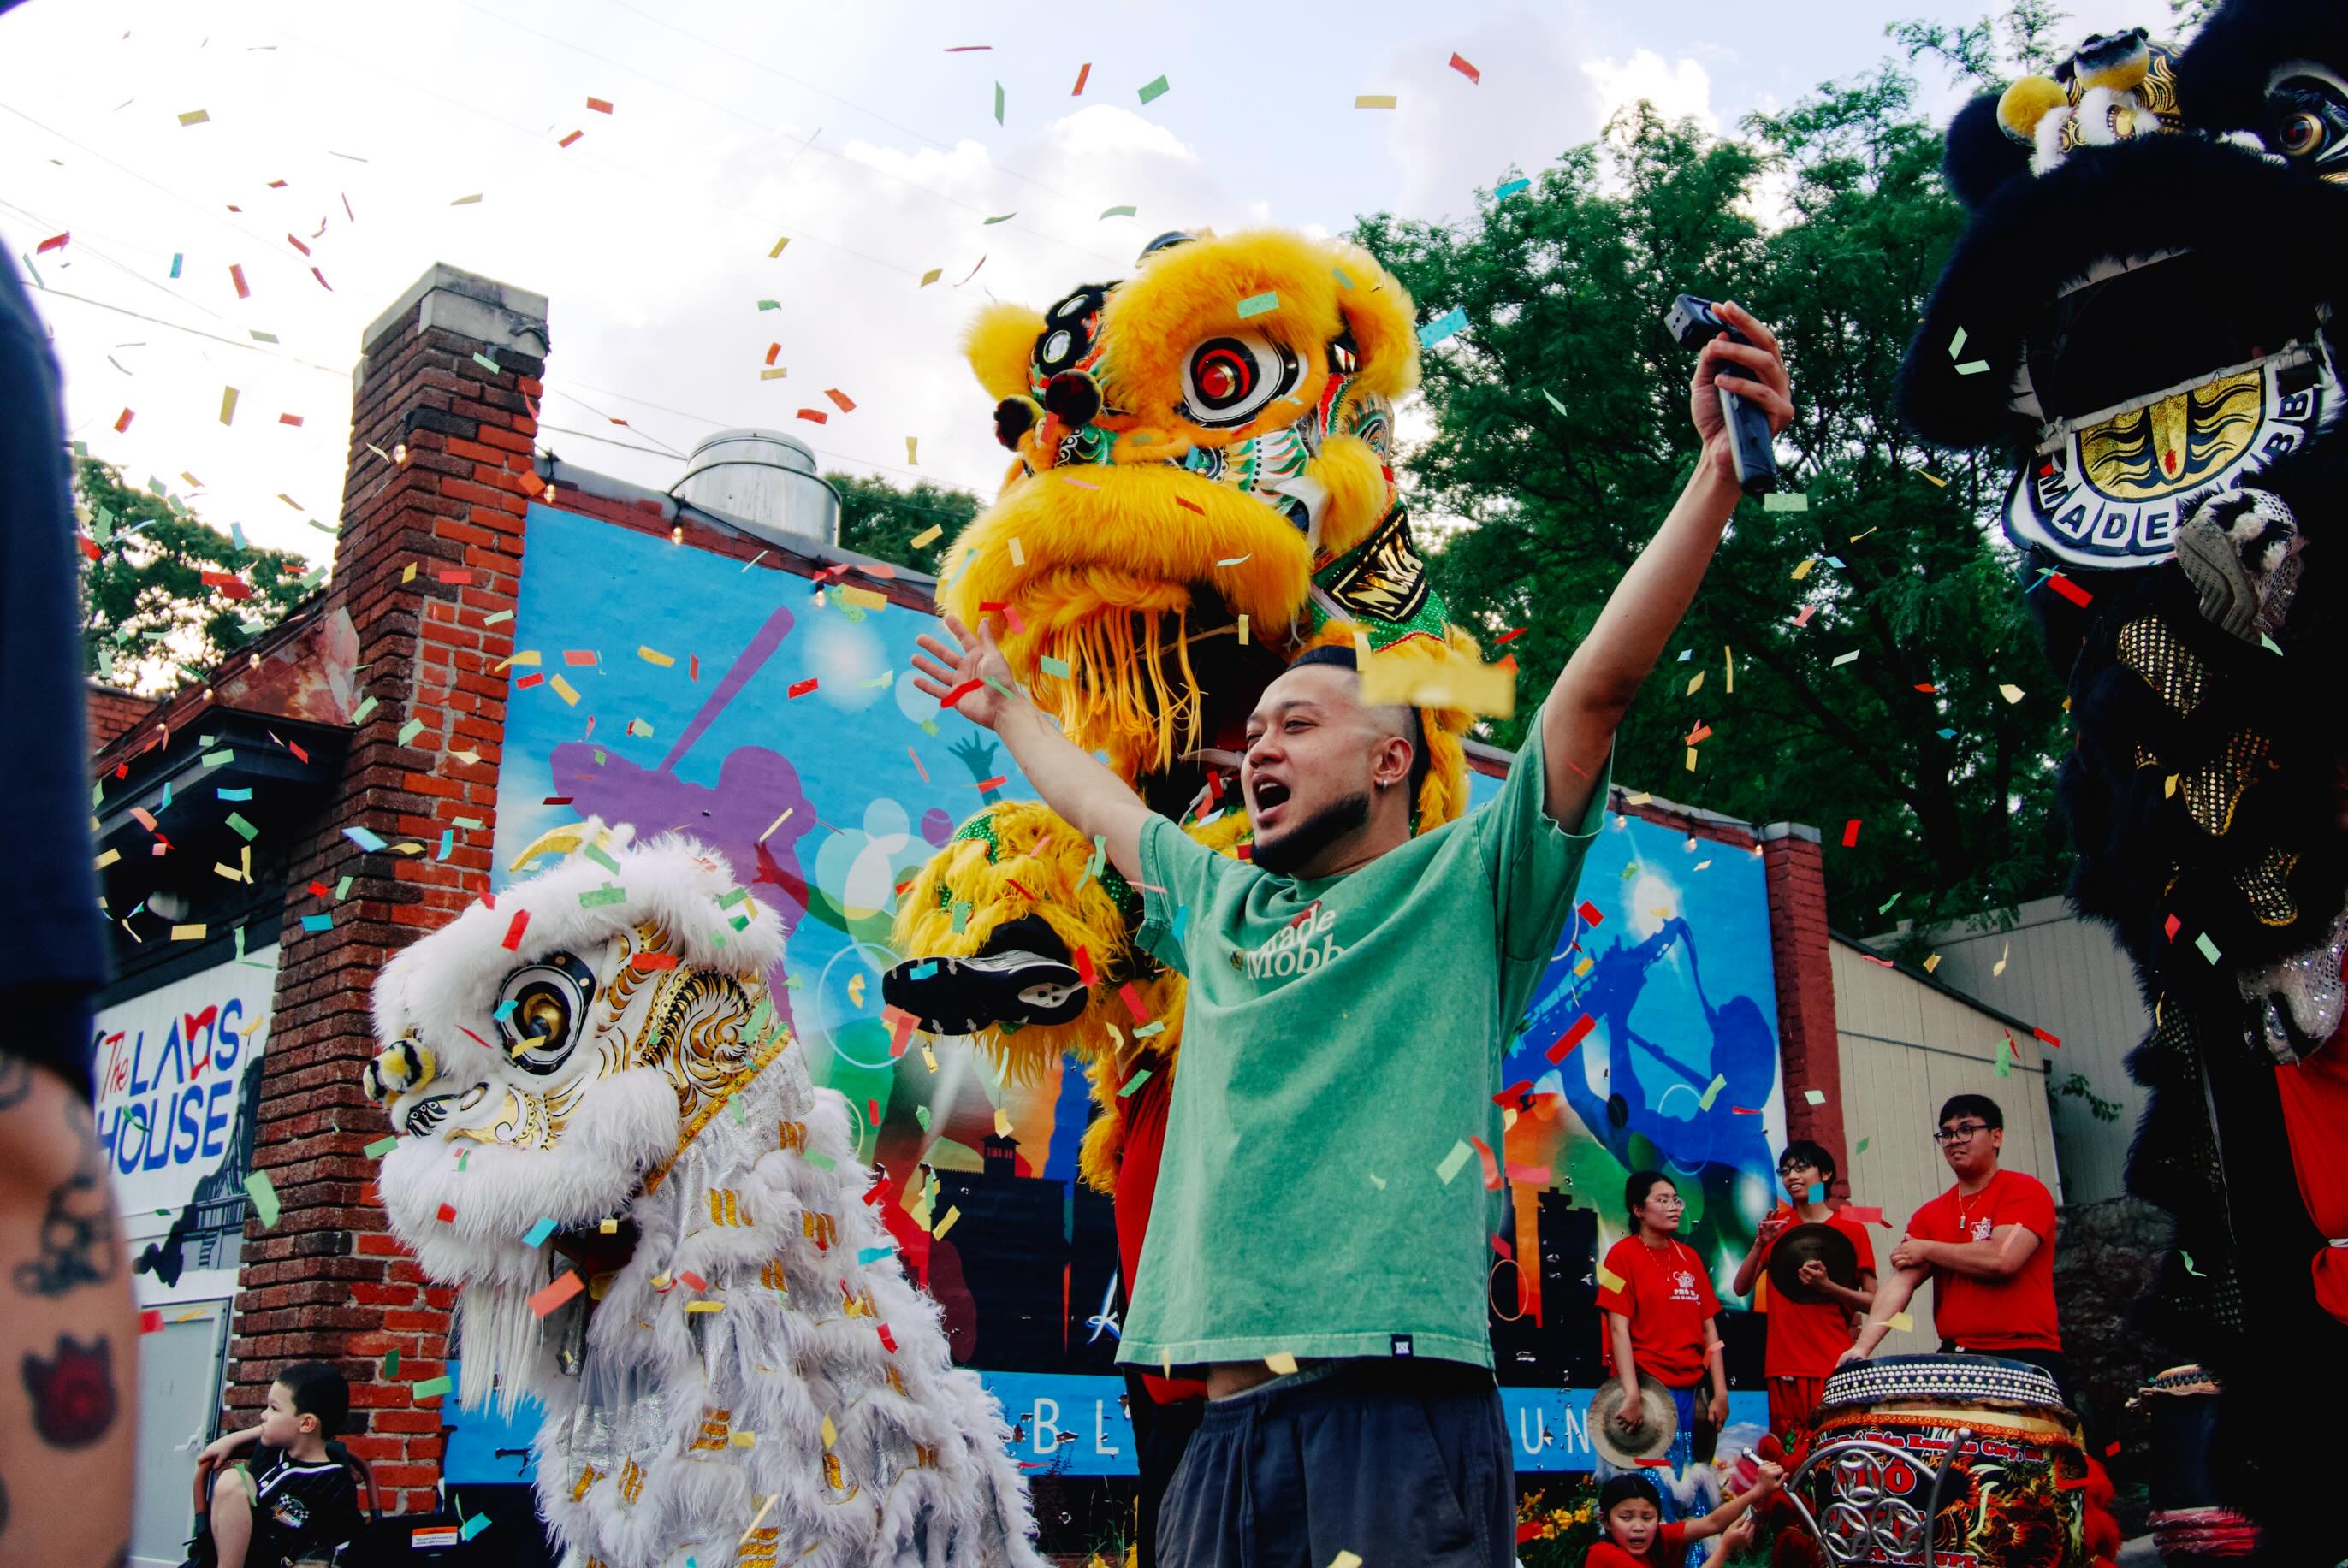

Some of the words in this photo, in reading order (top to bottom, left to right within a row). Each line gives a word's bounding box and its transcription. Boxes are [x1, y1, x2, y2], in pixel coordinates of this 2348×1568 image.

[2039, 471, 2170, 541] MADE
[1246, 933, 1346, 979] Mobb
[100, 1031, 128, 1102] The
[98, 1080, 233, 1175] HOUSE
